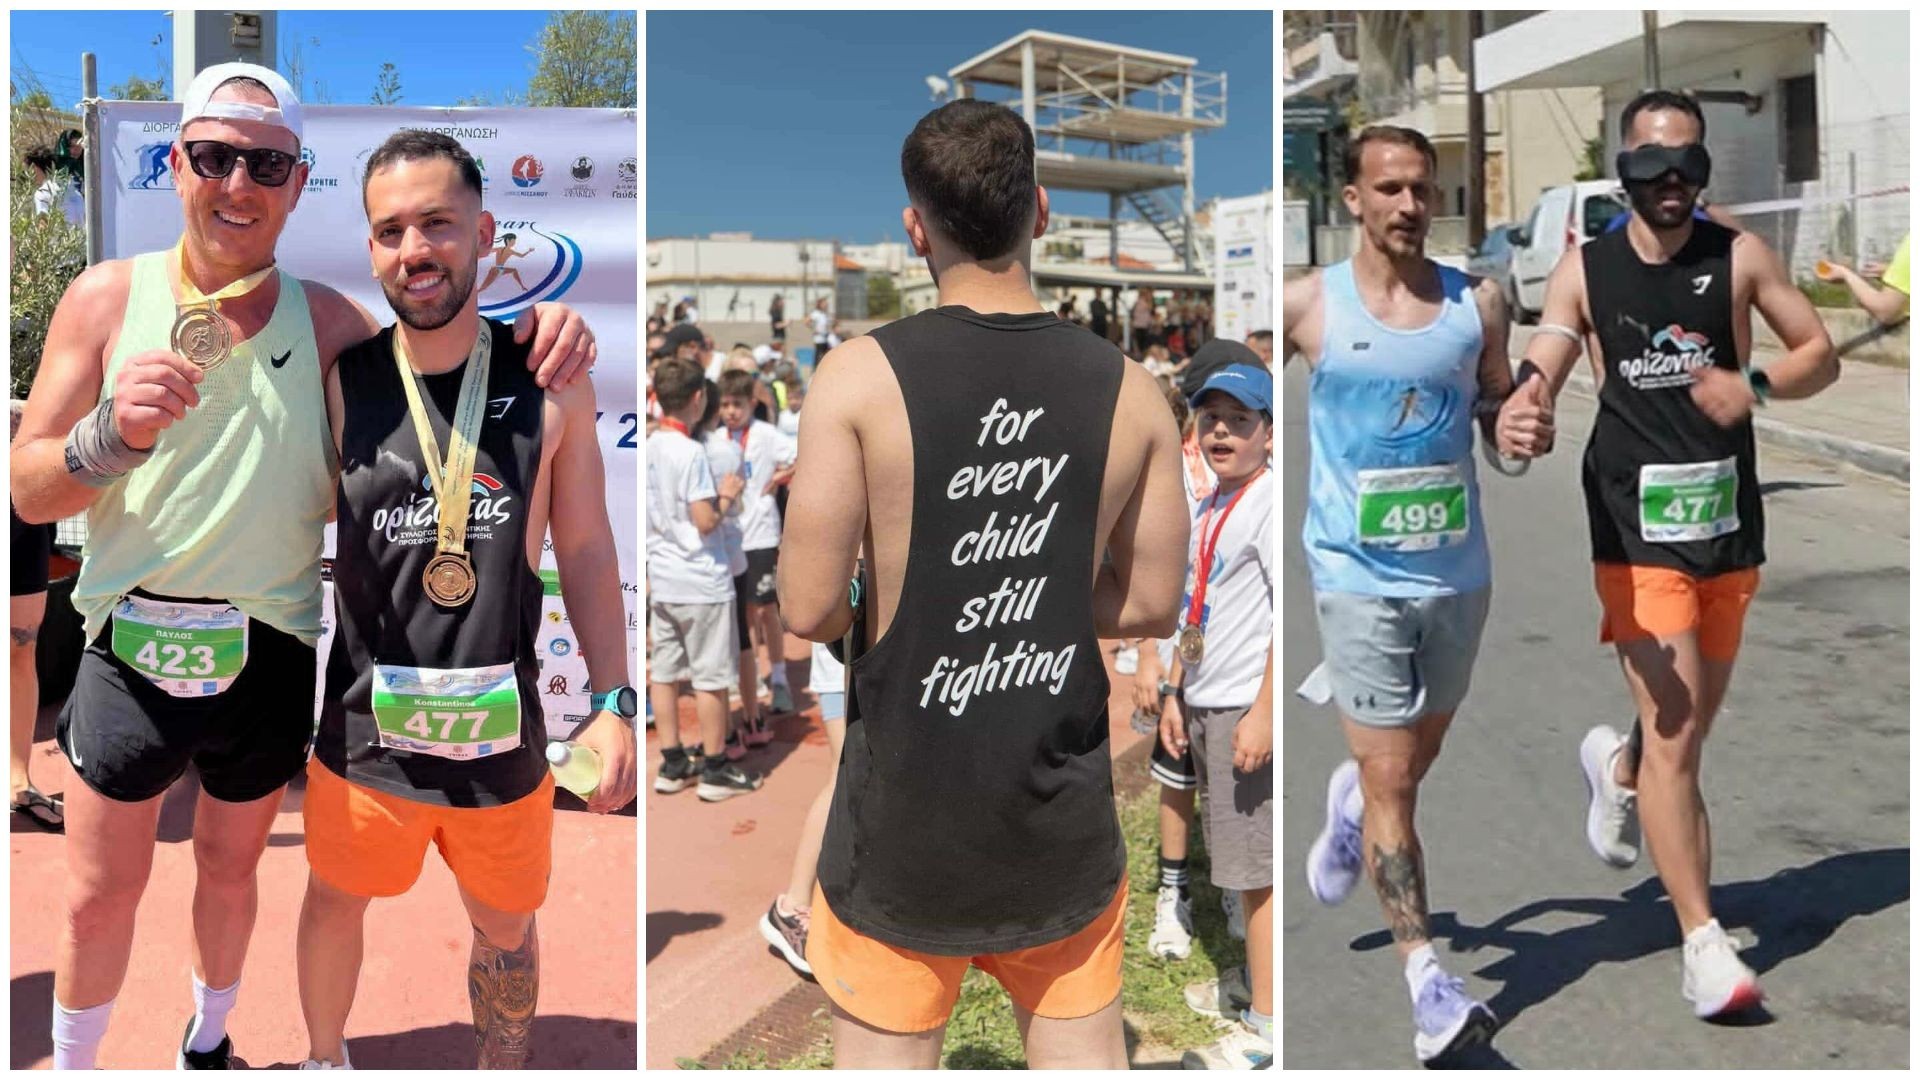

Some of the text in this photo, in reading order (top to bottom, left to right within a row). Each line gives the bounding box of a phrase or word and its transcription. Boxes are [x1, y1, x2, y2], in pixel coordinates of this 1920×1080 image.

[976, 397, 1045, 447] for
[946, 453, 1070, 504] every
[1381, 501, 1448, 533] 499
[1662, 491, 1724, 522] 477
[951, 501, 1060, 567] child
[955, 575, 1048, 633] still
[156, 630, 193, 640] ΠΑΥΛΟΣ
[135, 640, 216, 676] 423
[919, 639, 1078, 717] fighting
[404, 710, 490, 740] 477
